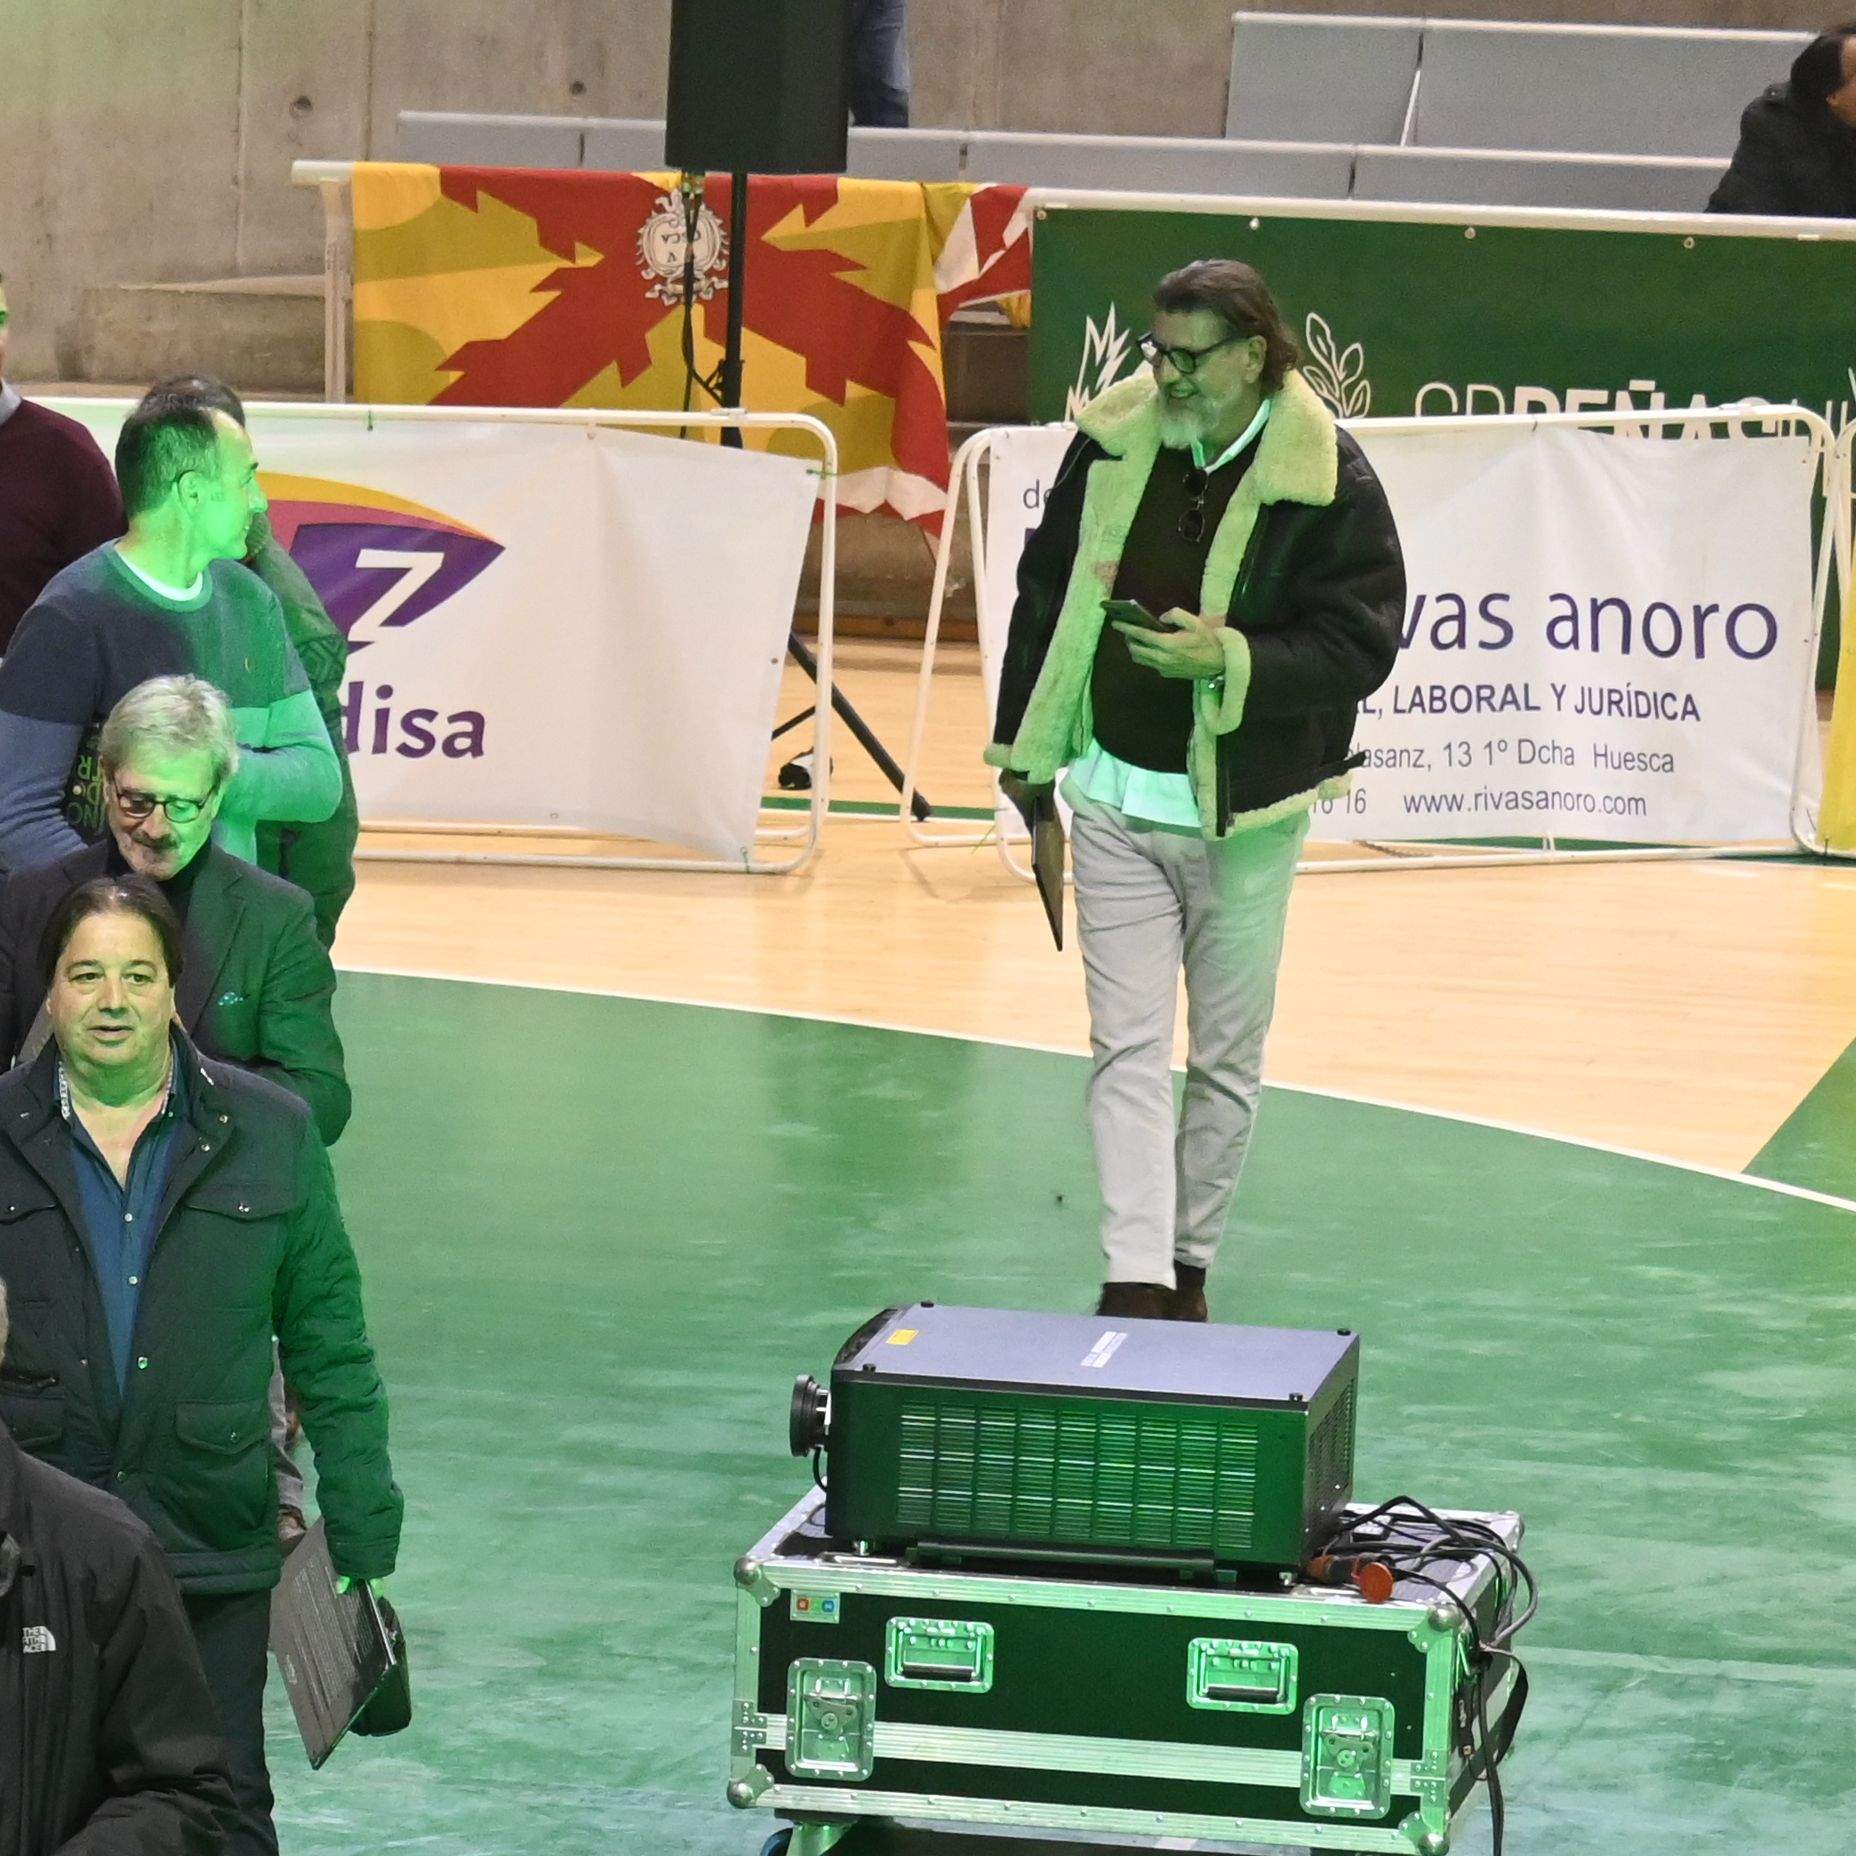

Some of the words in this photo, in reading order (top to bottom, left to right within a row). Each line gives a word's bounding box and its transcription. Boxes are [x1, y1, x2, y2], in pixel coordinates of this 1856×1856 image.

[1545, 592, 1779, 661] anoro
[1357, 698, 1384, 720] L,
[1393, 683, 1541, 715] LABORAL
[1550, 683, 1567, 710] Y
[1574, 682, 1702, 723] JURÍDICA
[1443, 740, 1472, 768] 13
[1517, 739, 1575, 766] Dcha
[1593, 743, 1675, 773] Huesca
[1346, 788, 1367, 814] 16
[1403, 786, 1648, 817] www.rivasanoro.com
